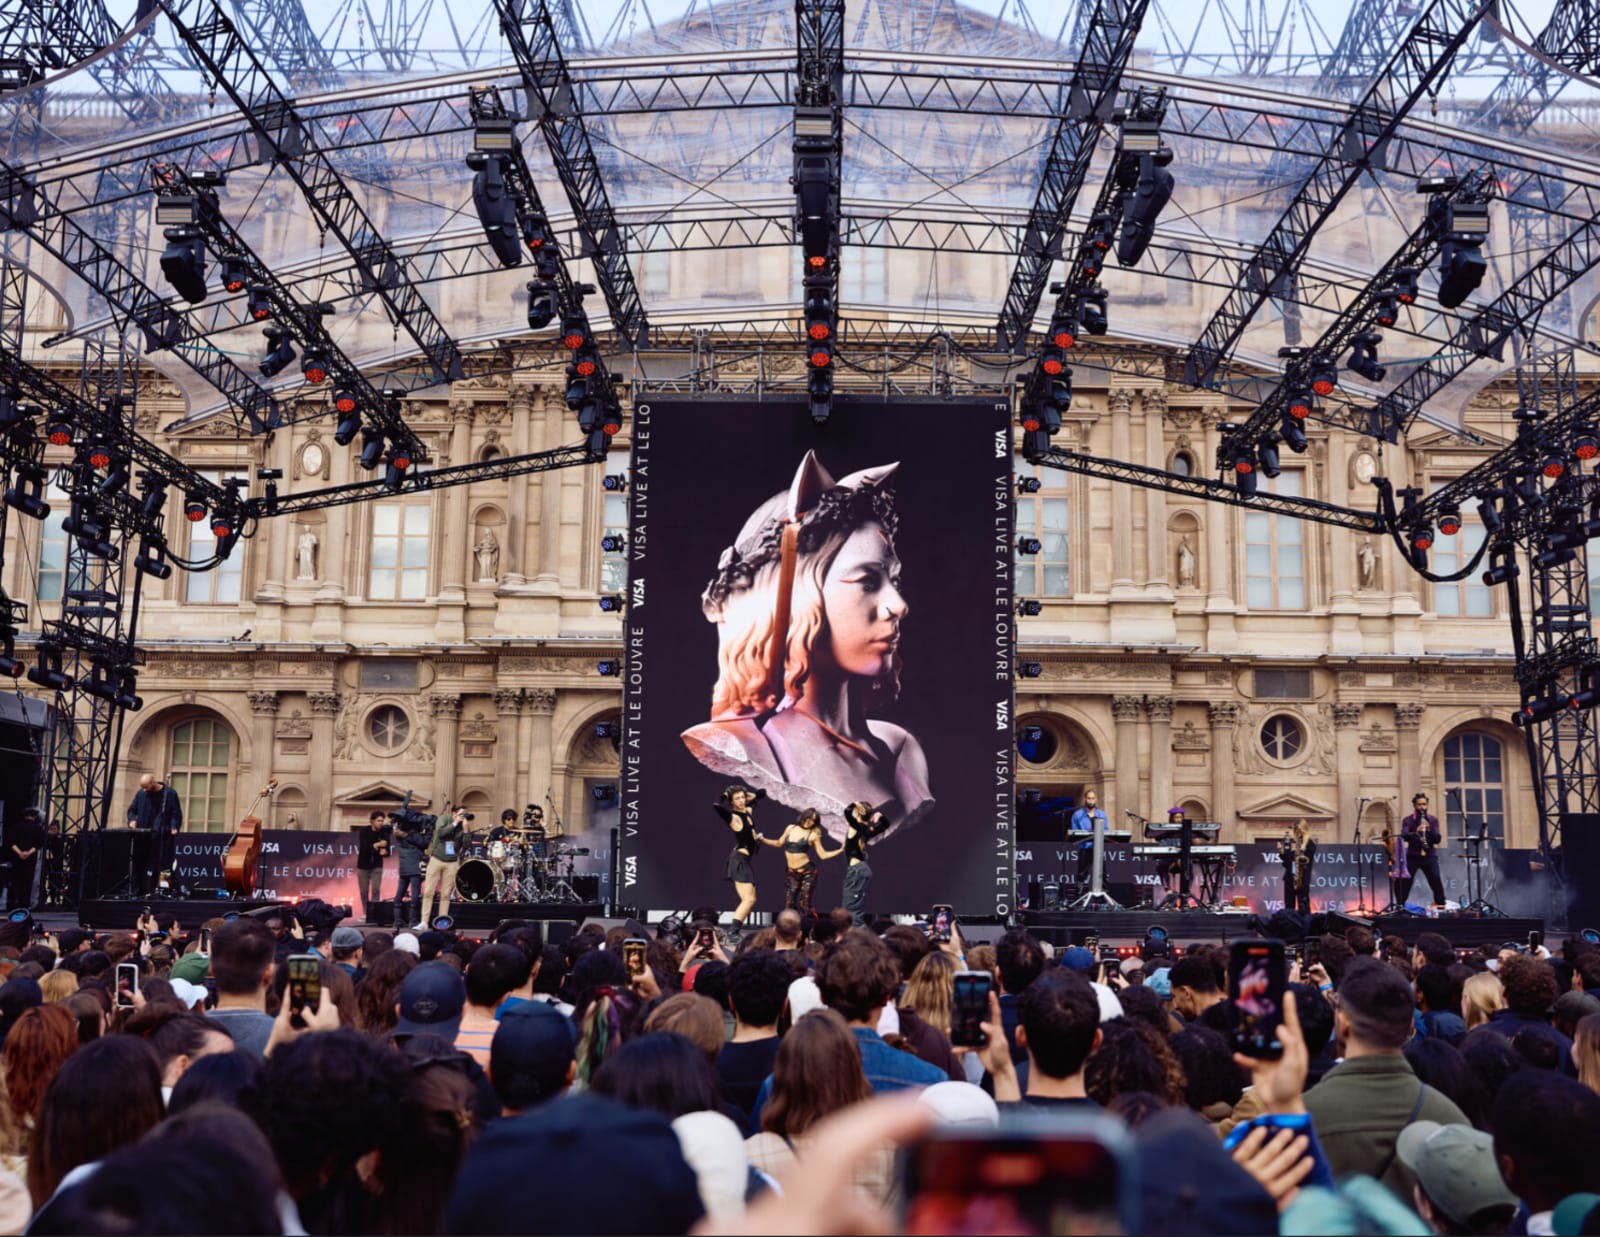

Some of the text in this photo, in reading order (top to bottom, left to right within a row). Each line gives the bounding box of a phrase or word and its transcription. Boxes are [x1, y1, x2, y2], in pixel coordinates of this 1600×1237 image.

[995, 428, 1007, 458] VISA
[995, 477, 1007, 510] VISA
[996, 518, 1007, 552] LIVE
[996, 561, 1008, 579] AT
[996, 588, 1007, 605] LE
[625, 404, 650, 888] VISA VISA LIVE AT LE LOUVRE VISA VISA LIVE AT LE LO
[996, 614, 1008, 680] LOUVRE
[996, 700, 1008, 731] VISA
[996, 750, 1009, 785] VISA
[997, 794, 1009, 829] LIVE
[261, 842, 280, 853] ISA
[303, 844, 334, 855] VISA
[997, 838, 1009, 858] AT
[1015, 850, 1033, 860] ISA
[1056, 851, 1079, 860] VIS
[1103, 850, 1125, 860] IVE
[1262, 852, 1382, 864] VIS VISA LIVE
[179, 867, 208, 877] VISA
[273, 866, 290, 877] LE
[295, 866, 354, 878] LOUVRE
[997, 867, 1009, 885] LE
[1134, 874, 1162, 885] VISA
[1223, 875, 1255, 886] LIVE
[1262, 876, 1279, 886] AT
[997, 893, 1009, 915] LO
[1264, 900, 1285, 911] VIS
